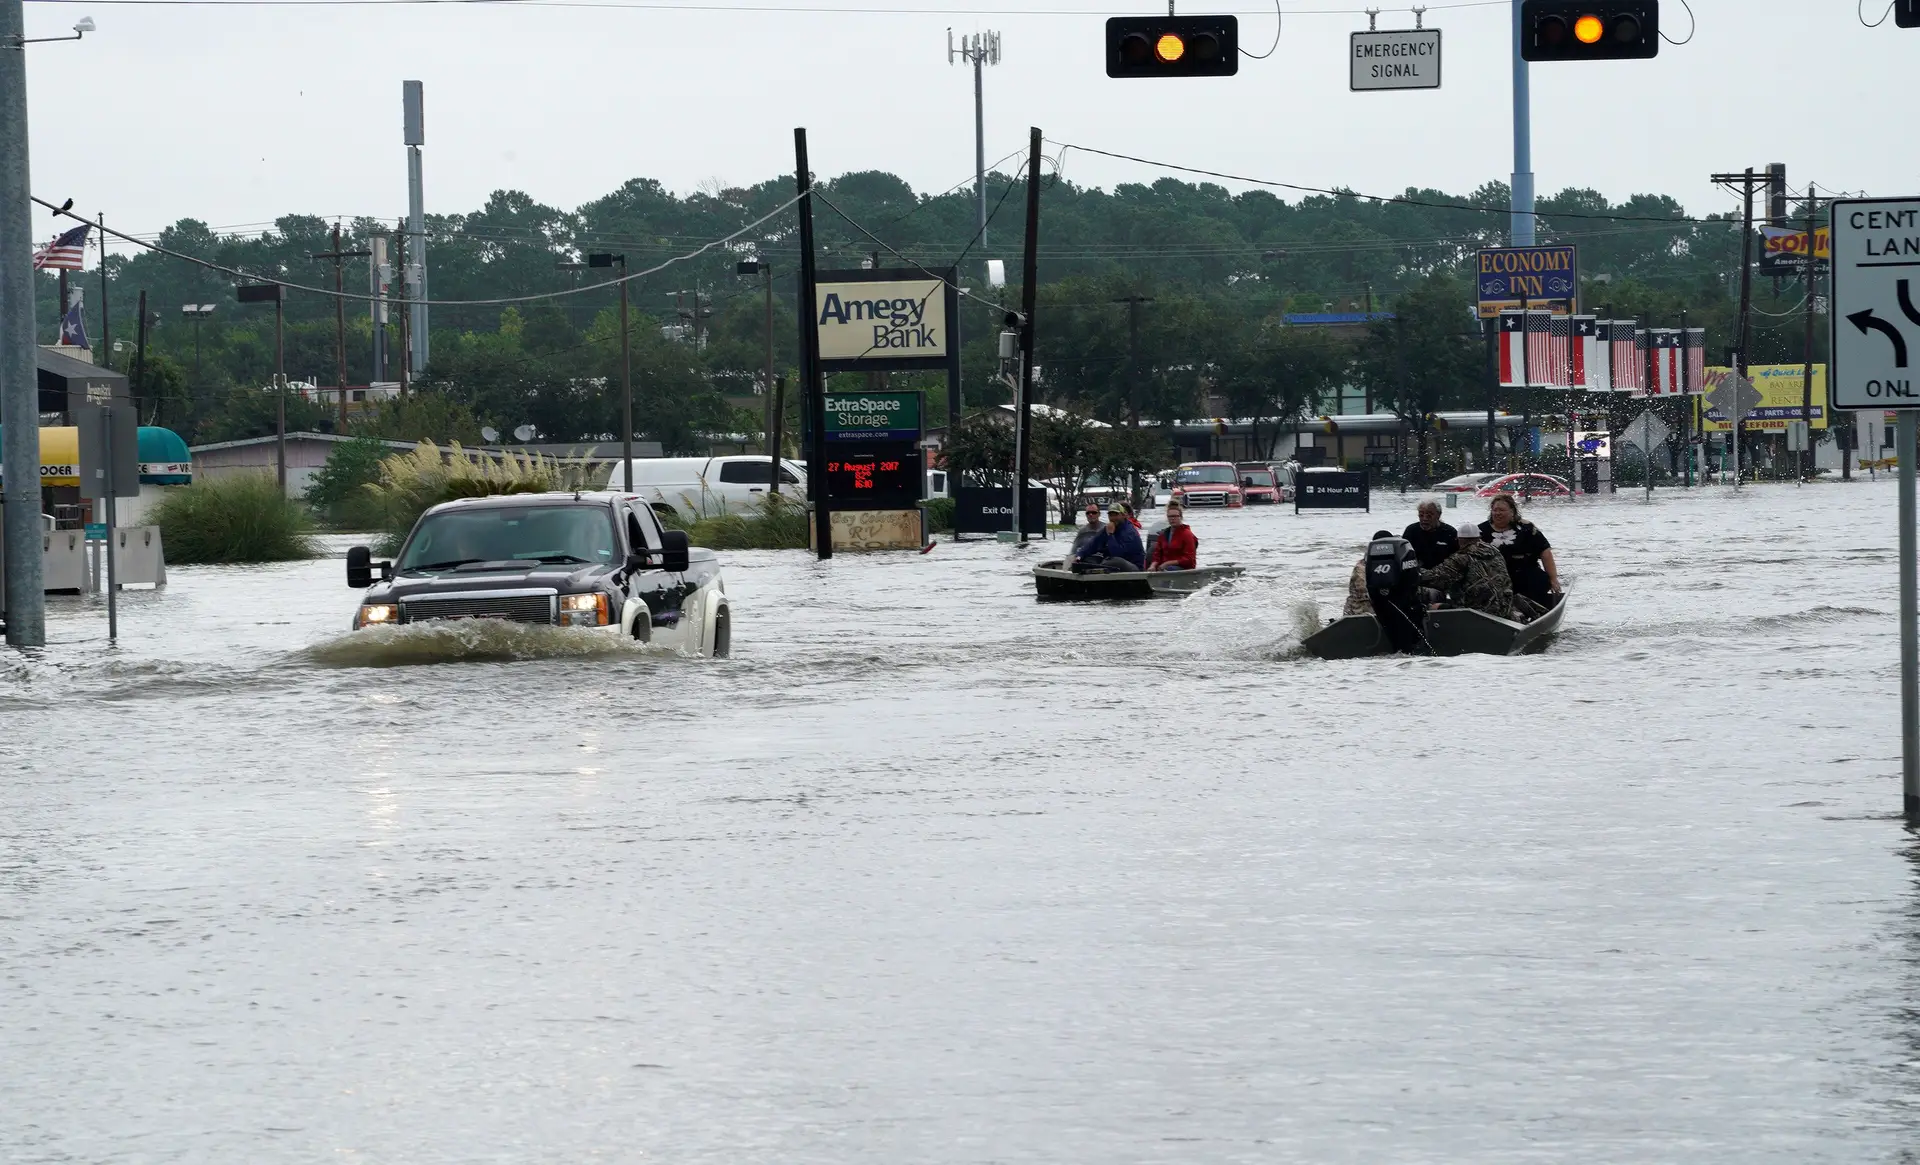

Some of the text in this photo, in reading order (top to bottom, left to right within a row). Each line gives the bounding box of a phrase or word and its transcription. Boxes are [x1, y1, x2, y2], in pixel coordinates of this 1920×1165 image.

[1356, 42, 1435, 58] EMERGENCY
[1371, 63, 1420, 78] SIGNAL
[1768, 234, 1830, 252] SONI
[1481, 251, 1571, 273] ECONOMY
[1509, 275, 1543, 296] INN
[819, 293, 926, 327] Amegy
[873, 323, 937, 348] Bank
[825, 398, 900, 413] ExtraSpace
[838, 412, 888, 427] Storage
[828, 461, 899, 471] 27 August 2017
[983, 506, 1013, 514] Exit Onl
[1374, 564, 1391, 574] 40
